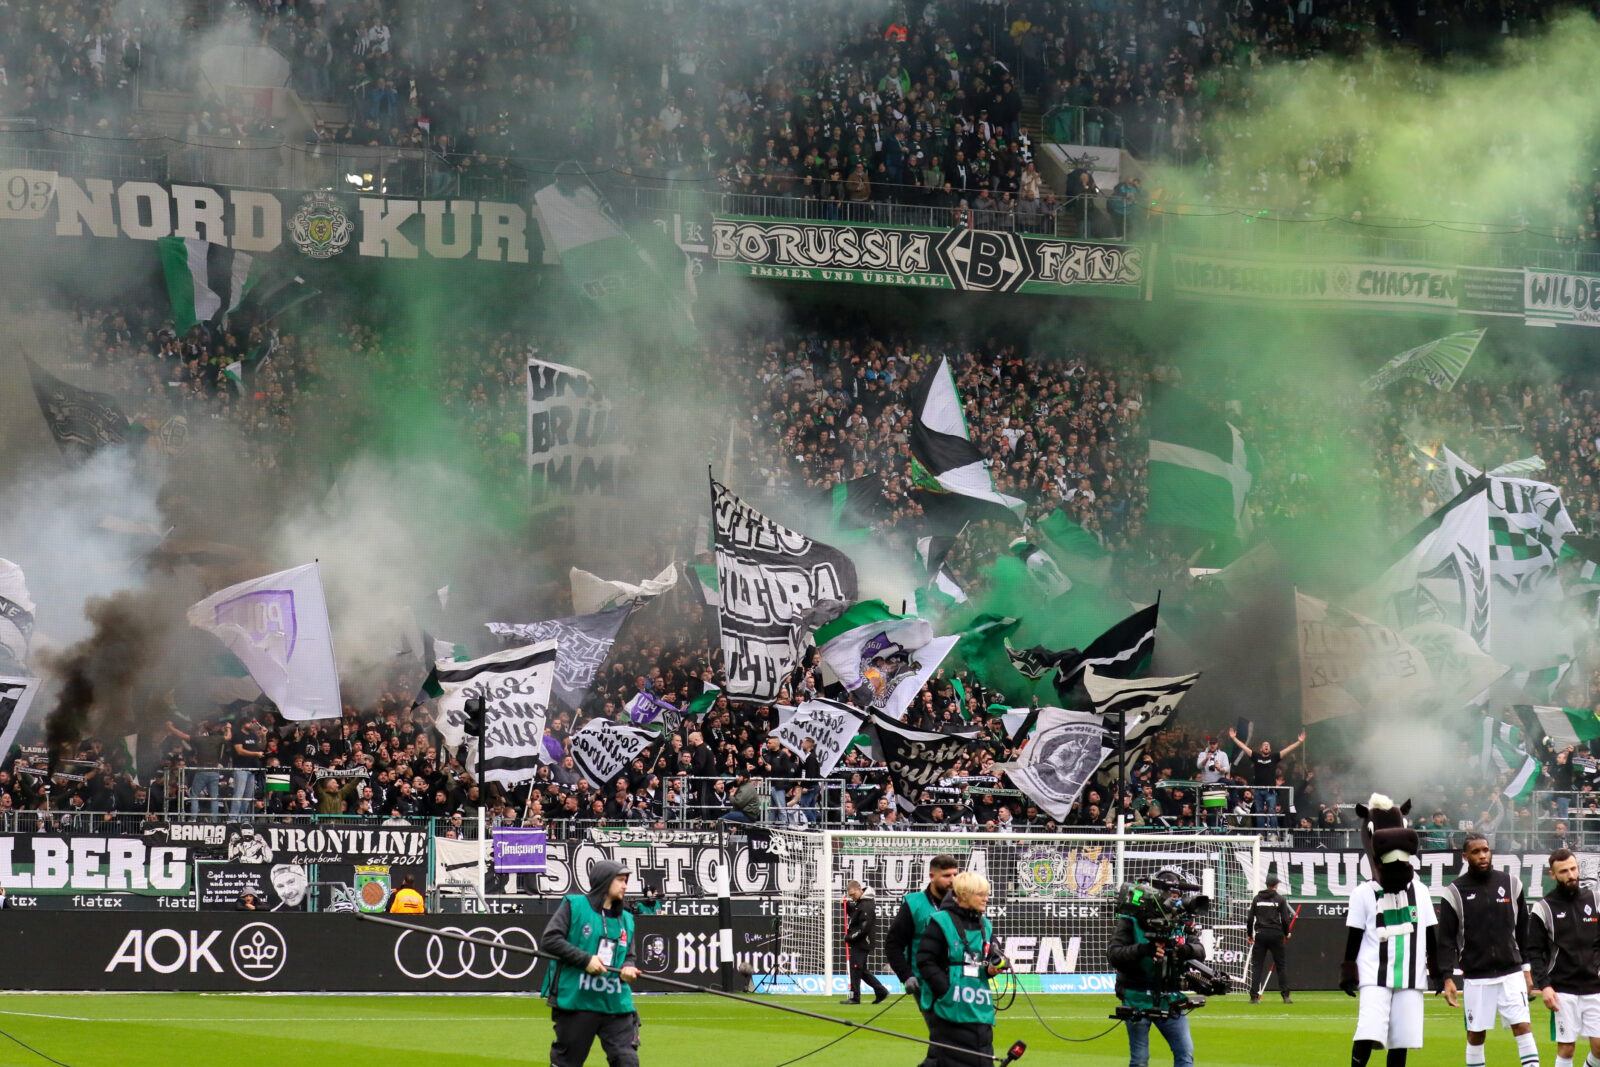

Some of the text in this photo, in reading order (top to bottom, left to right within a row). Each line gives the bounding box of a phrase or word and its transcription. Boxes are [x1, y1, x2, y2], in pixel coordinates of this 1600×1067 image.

[6, 174, 52, 211] 93
[50, 176, 561, 265] NORD KUR
[712, 222, 930, 272] BORUSSIA
[1037, 244, 1143, 285] FANS
[750, 266, 945, 287] IMMER UND ÜBERALL!
[1356, 269, 1458, 301] CHAOTEN
[170, 824, 227, 842] BANDA
[204, 836, 224, 845] SUD
[268, 828, 428, 856] FRONTLINE
[0, 836, 188, 890] LBERG
[366, 854, 388, 866] seit
[391, 855, 425, 866] 2006
[9, 895, 37, 908] tex
[72, 895, 123, 908] flatex
[157, 895, 196, 908] flate
[661, 901, 720, 916] flatex
[1042, 903, 1099, 917] flatex
[1316, 904, 1349, 916] flat
[104, 929, 225, 974] AOK
[673, 931, 801, 975] Biturger
[579, 973, 623, 994] HOST
